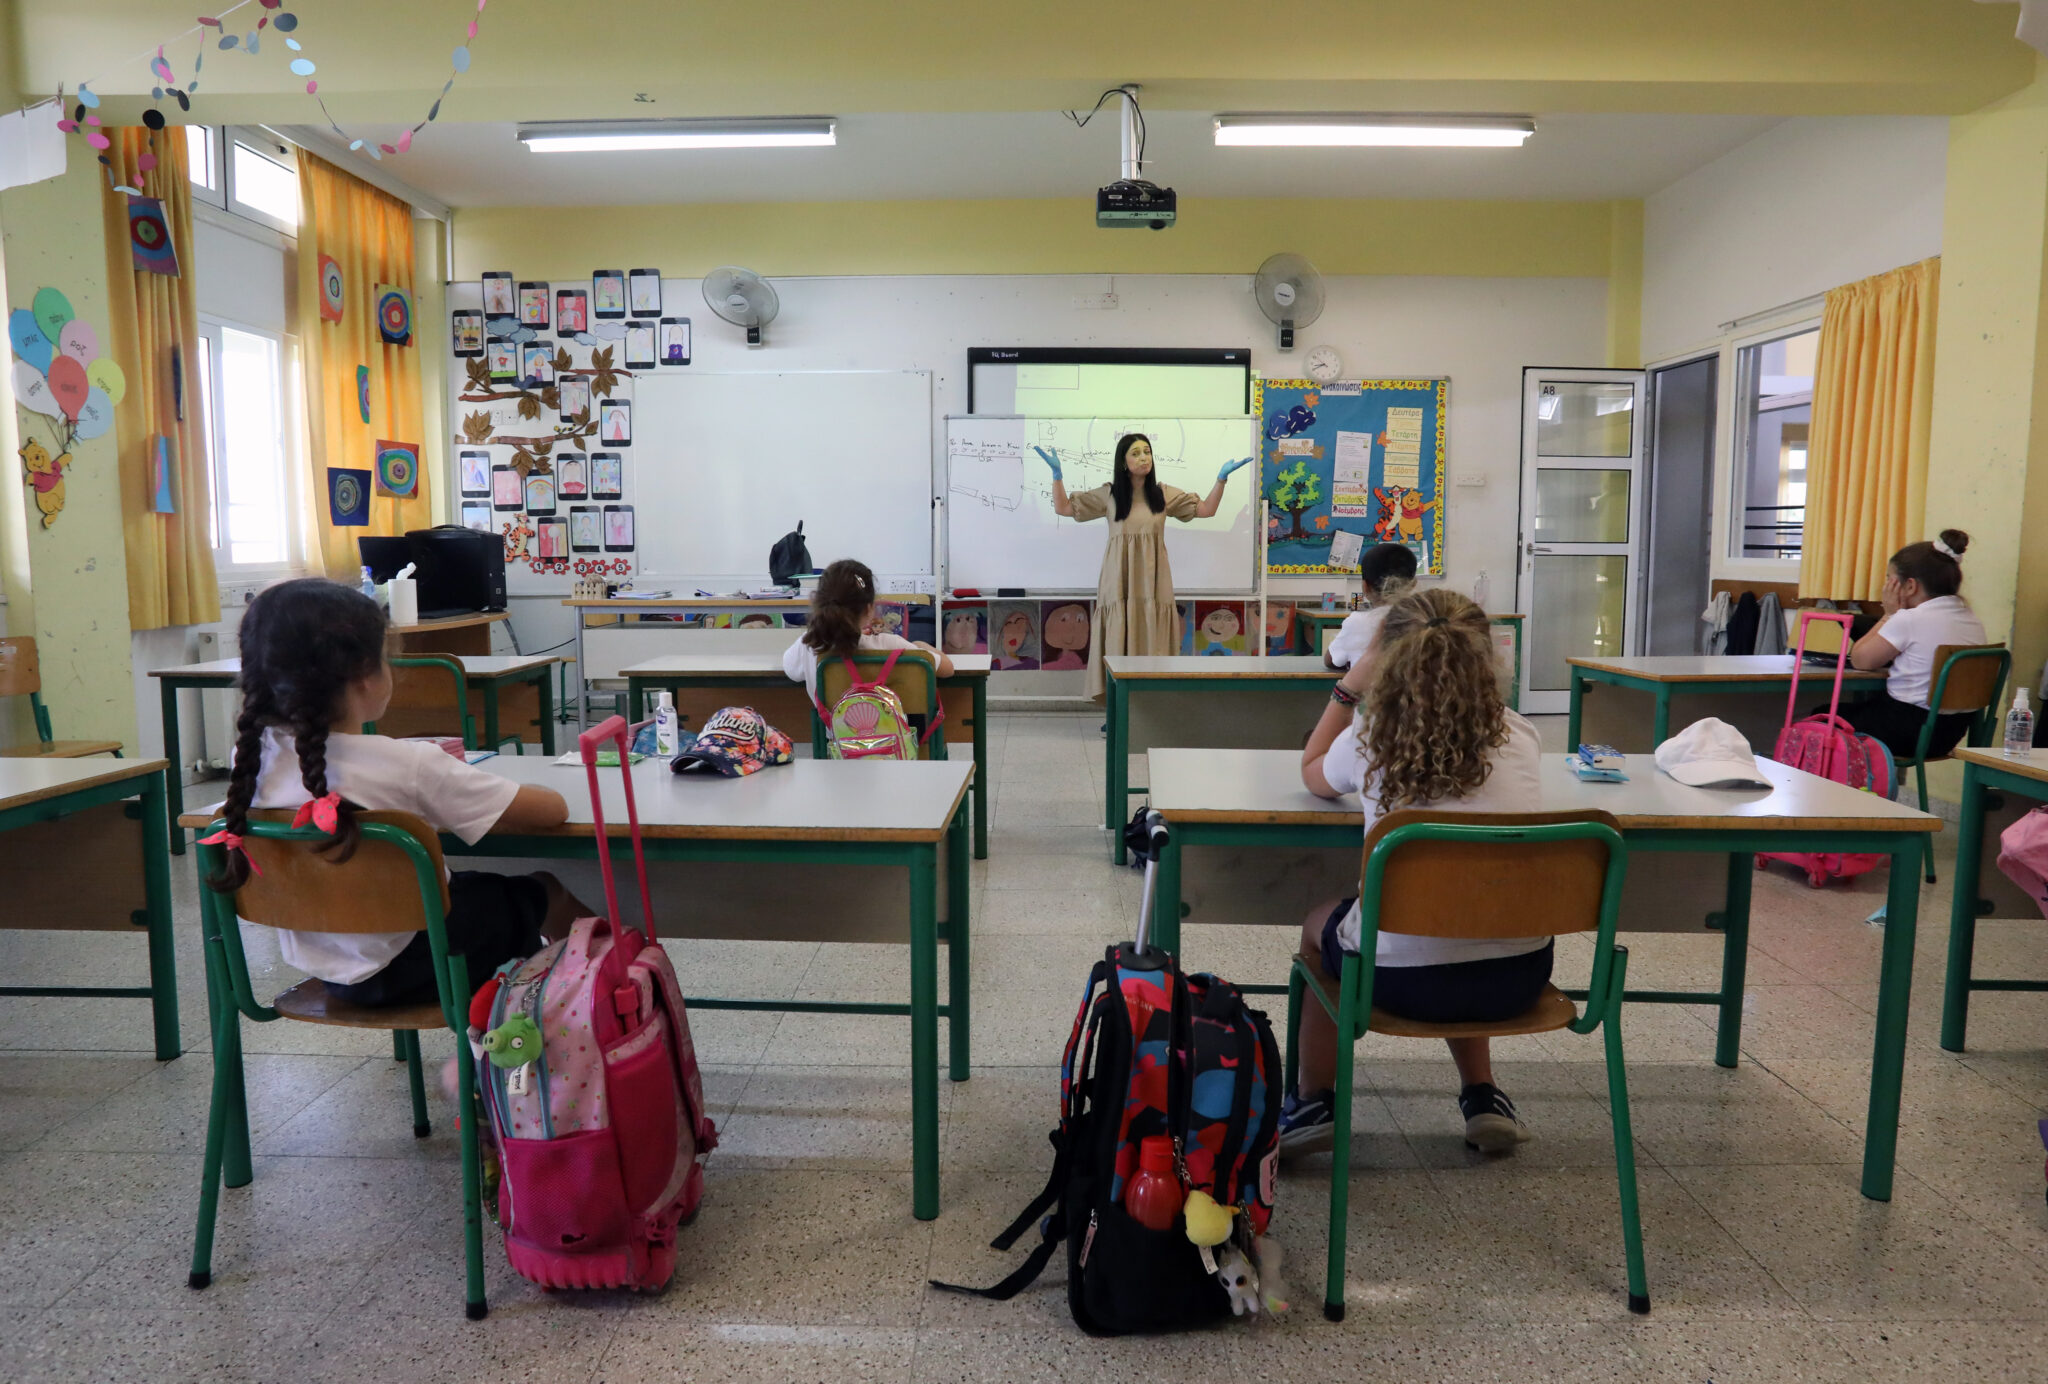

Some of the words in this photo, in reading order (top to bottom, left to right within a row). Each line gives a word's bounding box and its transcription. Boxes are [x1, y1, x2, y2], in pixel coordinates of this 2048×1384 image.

[70, 340, 87, 357] ροζ
[1543, 385, 1555, 396] A8
[1391, 407, 1420, 417] Δευτέρα
[1391, 429, 1418, 439] Τετάρτη
